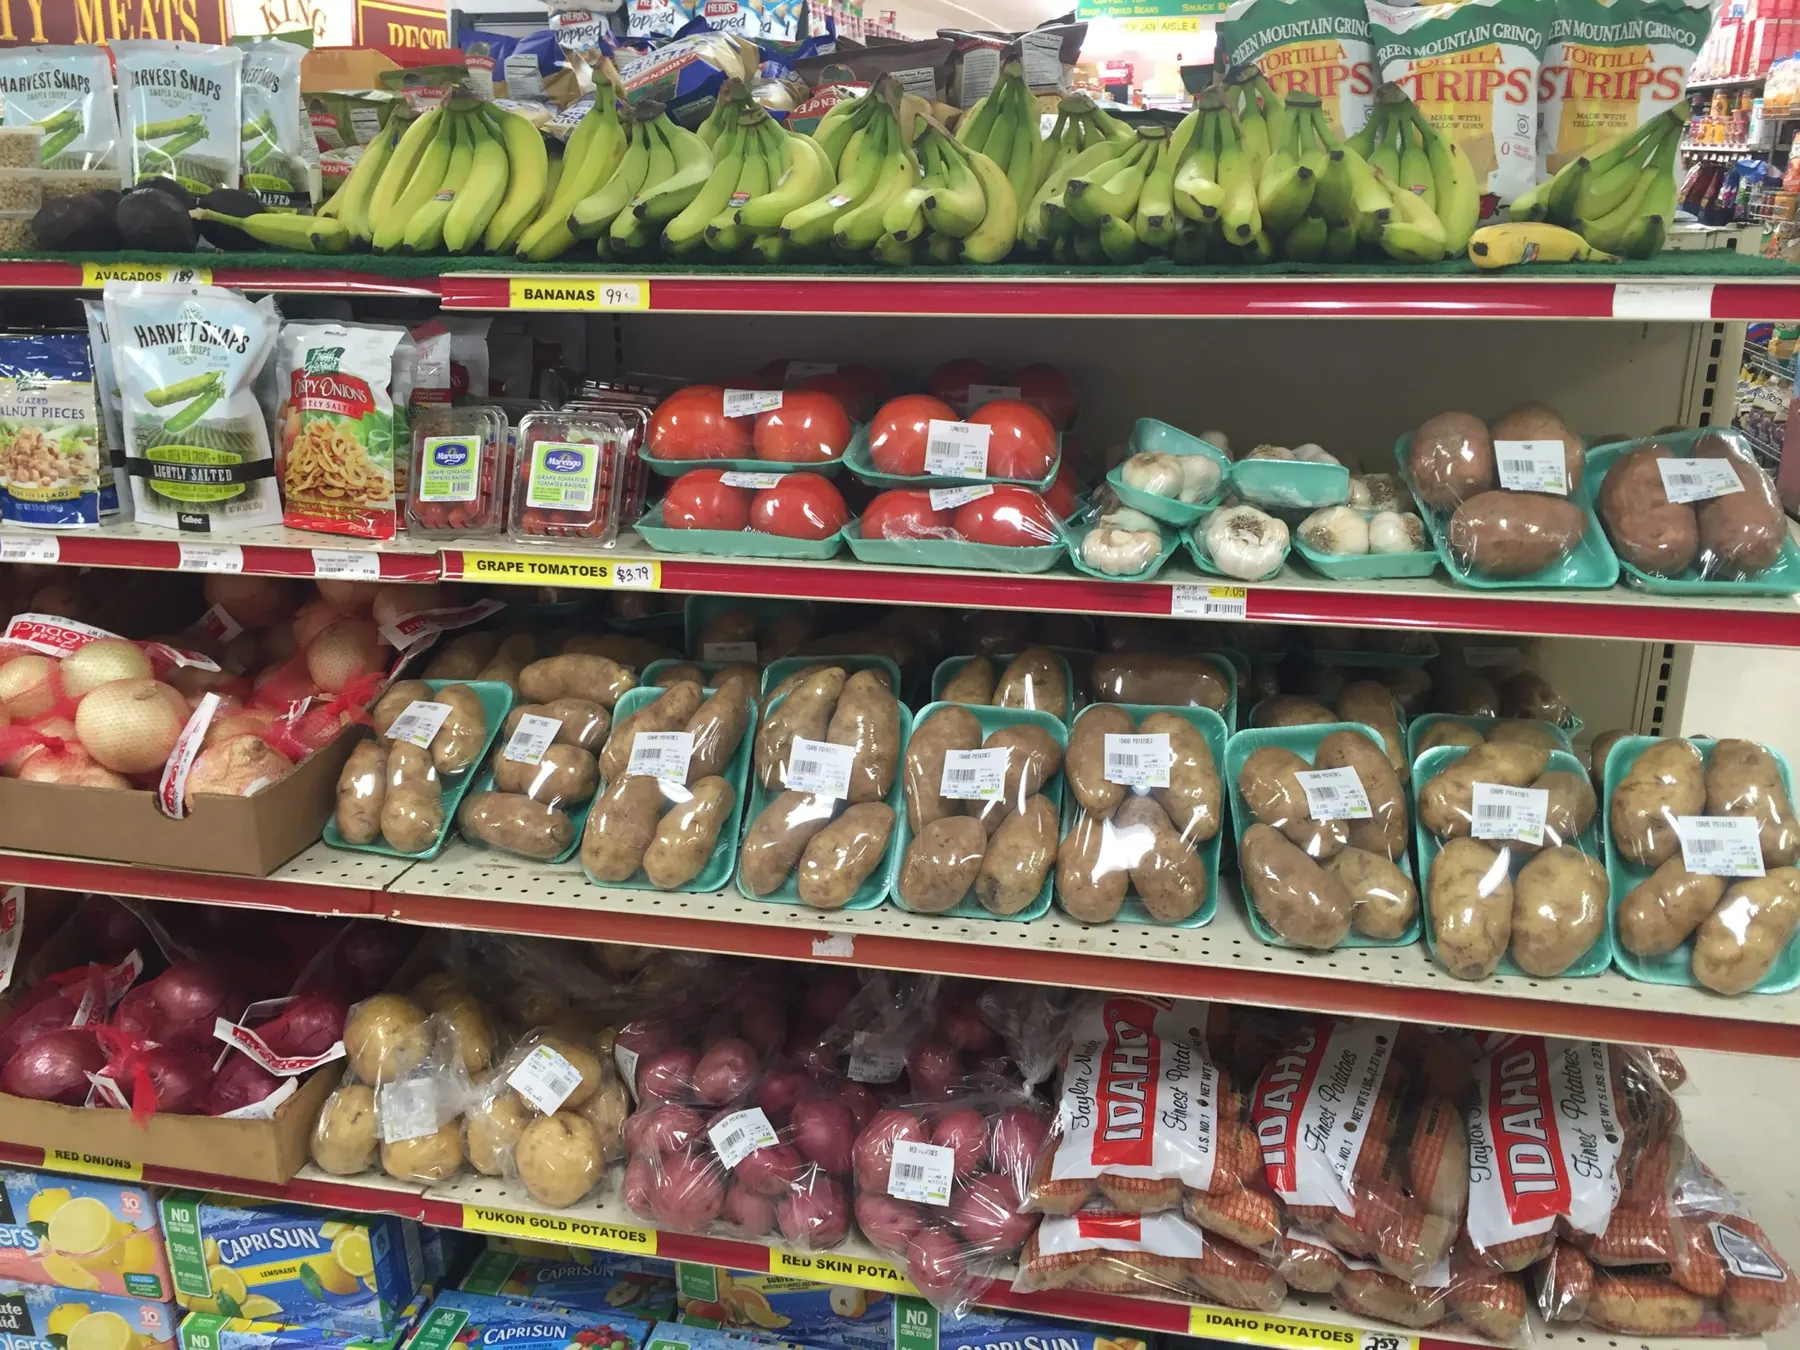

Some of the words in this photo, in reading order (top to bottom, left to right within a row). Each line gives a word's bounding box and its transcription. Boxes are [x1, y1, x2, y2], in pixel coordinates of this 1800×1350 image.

[1134, 6, 1159, 14] BEANS
[1182, 3, 1214, 12] SNACK
[75, 0, 200, 46] MEATS
[260, 0, 327, 39] KING
[1161, 22, 1188, 31] AISLE
[1190, 22, 1197, 30] 4
[1257, 17, 1333, 48] MOUNTAIN
[1414, 27, 1490, 57] MOUNTAIN
[1491, 21, 1542, 50] GRINGO
[1573, 19, 1644, 41] MOUNTAIN
[1644, 19, 1696, 47] GRINGO
[1256, 44, 1348, 73] TORTILLA
[1407, 42, 1505, 71] TORTILLA
[1562, 44, 1655, 67] TORTILLA
[0, 71, 51, 94] HARVEST
[54, 69, 91, 95] SNAPS
[180, 69, 222, 101] SNAPS
[1538, 66, 1684, 102] STRIPS
[1457, 114, 1481, 122] WITH
[1572, 120, 1602, 128] YELLOW
[1576, 112, 1601, 120] MADE
[1603, 112, 1627, 121] WITH
[95, 271, 163, 282] AVACADOS
[524, 288, 595, 301] BANANAS
[134, 322, 195, 349] HARVEST
[200, 321, 250, 354] SNAPS
[320, 376, 368, 404] ONIONS
[42, 407, 85, 420] PIECES
[436, 451, 466, 463] Marengo
[547, 456, 581, 468] Marengo
[153, 464, 187, 481] LIGHTLY
[191, 468, 233, 482] SALTED
[558, 475, 588, 483] TOMATOES
[537, 480, 564, 488] TOMATES
[565, 481, 587, 489] RAISINS
[181, 514, 203, 525] Calbee
[477, 559, 524, 574] GRAPE
[528, 561, 607, 577] TOMATOES
[617, 566, 649, 582] $3.79
[1224, 586, 1245, 597] 7.05
[1102, 1019, 1151, 1142] IDAHO
[1318, 1048, 1358, 1103] Potatoes
[1560, 1048, 1587, 1121] Potatoes
[1200, 1081, 1211, 1099] NET
[1257, 1027, 1317, 1165] IDAHO
[1068, 1078, 1097, 1131] Taylor
[1162, 1085, 1189, 1132] Finest
[1355, 1095, 1367, 1110] WT
[1600, 1102, 1613, 1116] WT
[1350, 1107, 1363, 1123] NET
[1500, 1049, 1560, 1196] IDAHO
[1304, 1104, 1337, 1153] Finest
[1198, 1132, 1210, 1153] U.S.
[1469, 1121, 1494, 1184] Taylor
[1570, 1127, 1603, 1179] Finest
[55, 1149, 80, 1162] RED
[83, 1153, 131, 1169] ONIONS
[122, 1197, 139, 1210] 10
[171, 1207, 190, 1223] NO
[475, 1209, 526, 1226] YUKON
[529, 1216, 568, 1232] GOLD
[571, 1223, 647, 1244] POTATOES
[260, 1266, 297, 1279] LEMONADE
[782, 1253, 811, 1268] RED
[816, 1258, 852, 1274] SKIN
[140, 1309, 160, 1323] 10
[906, 1308, 928, 1326] NO
[1206, 1313, 1258, 1331] IDAHO
[1264, 1321, 1355, 1344] POTATOES
[191, 1333, 210, 1349] NO
